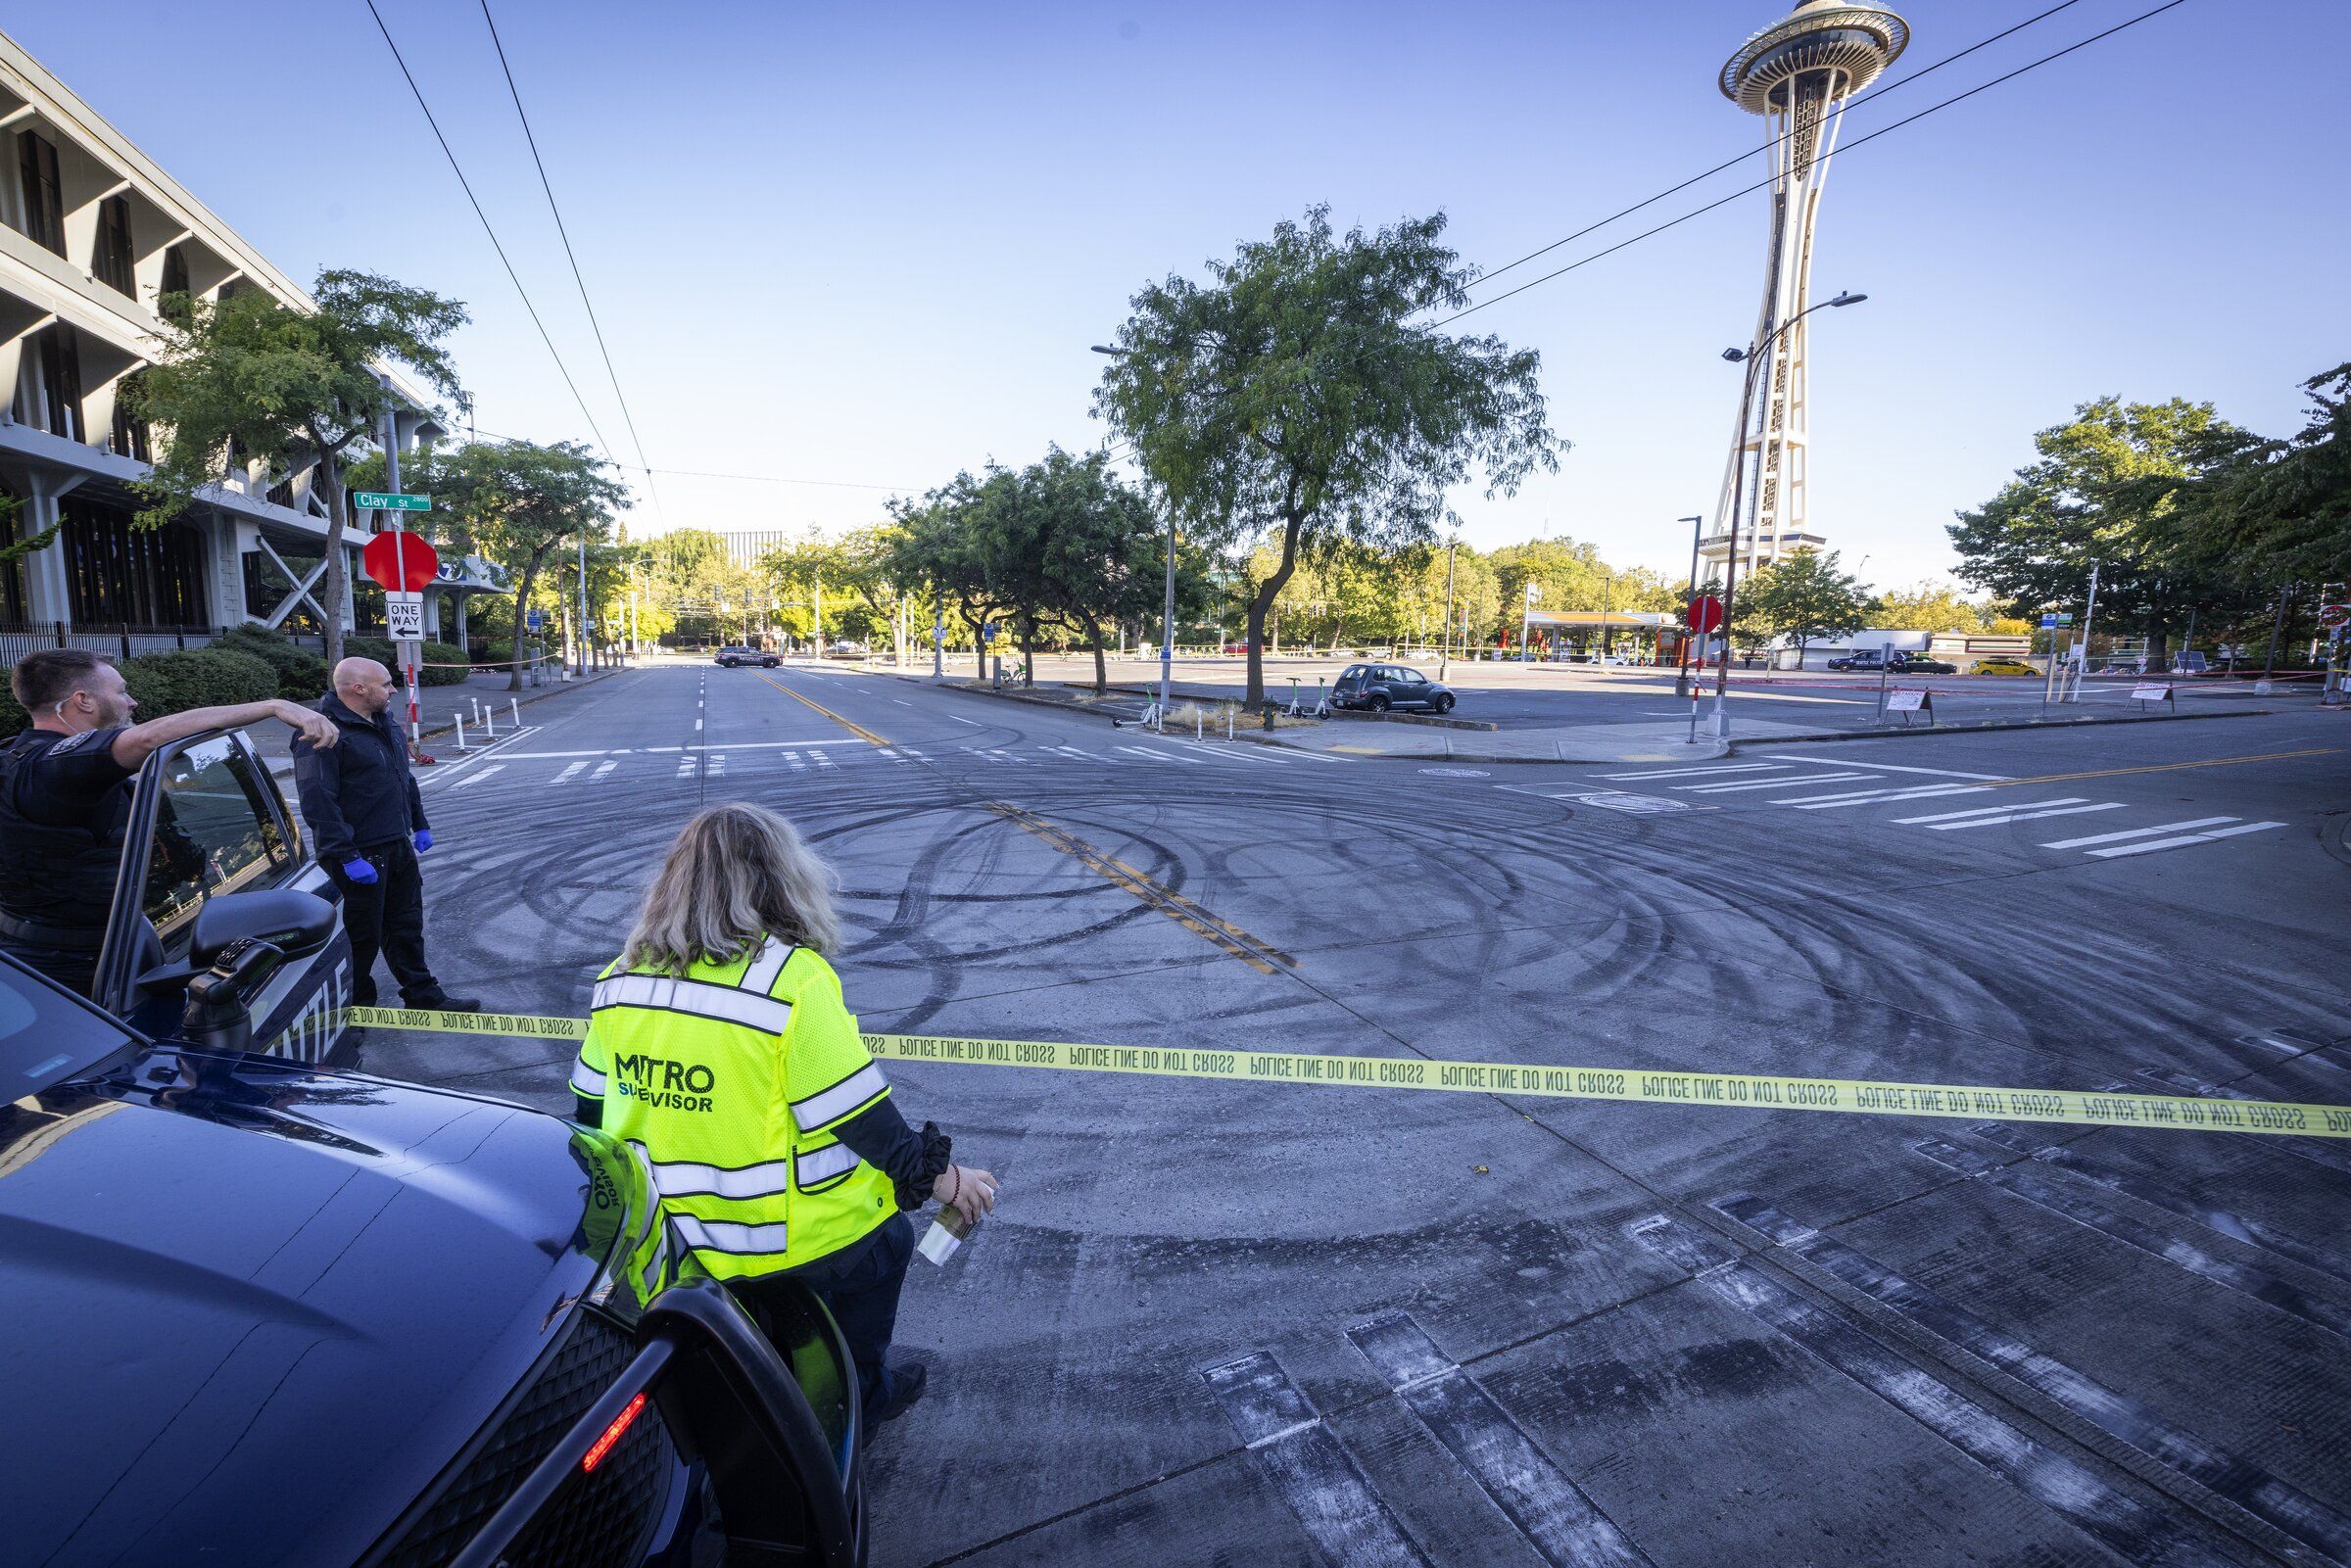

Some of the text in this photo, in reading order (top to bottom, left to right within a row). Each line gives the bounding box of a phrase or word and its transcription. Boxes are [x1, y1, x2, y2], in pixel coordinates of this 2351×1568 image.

[360, 495, 388, 507] Clay
[392, 605, 417, 615] ONE
[618, 1082, 713, 1113] SUEVISOR
